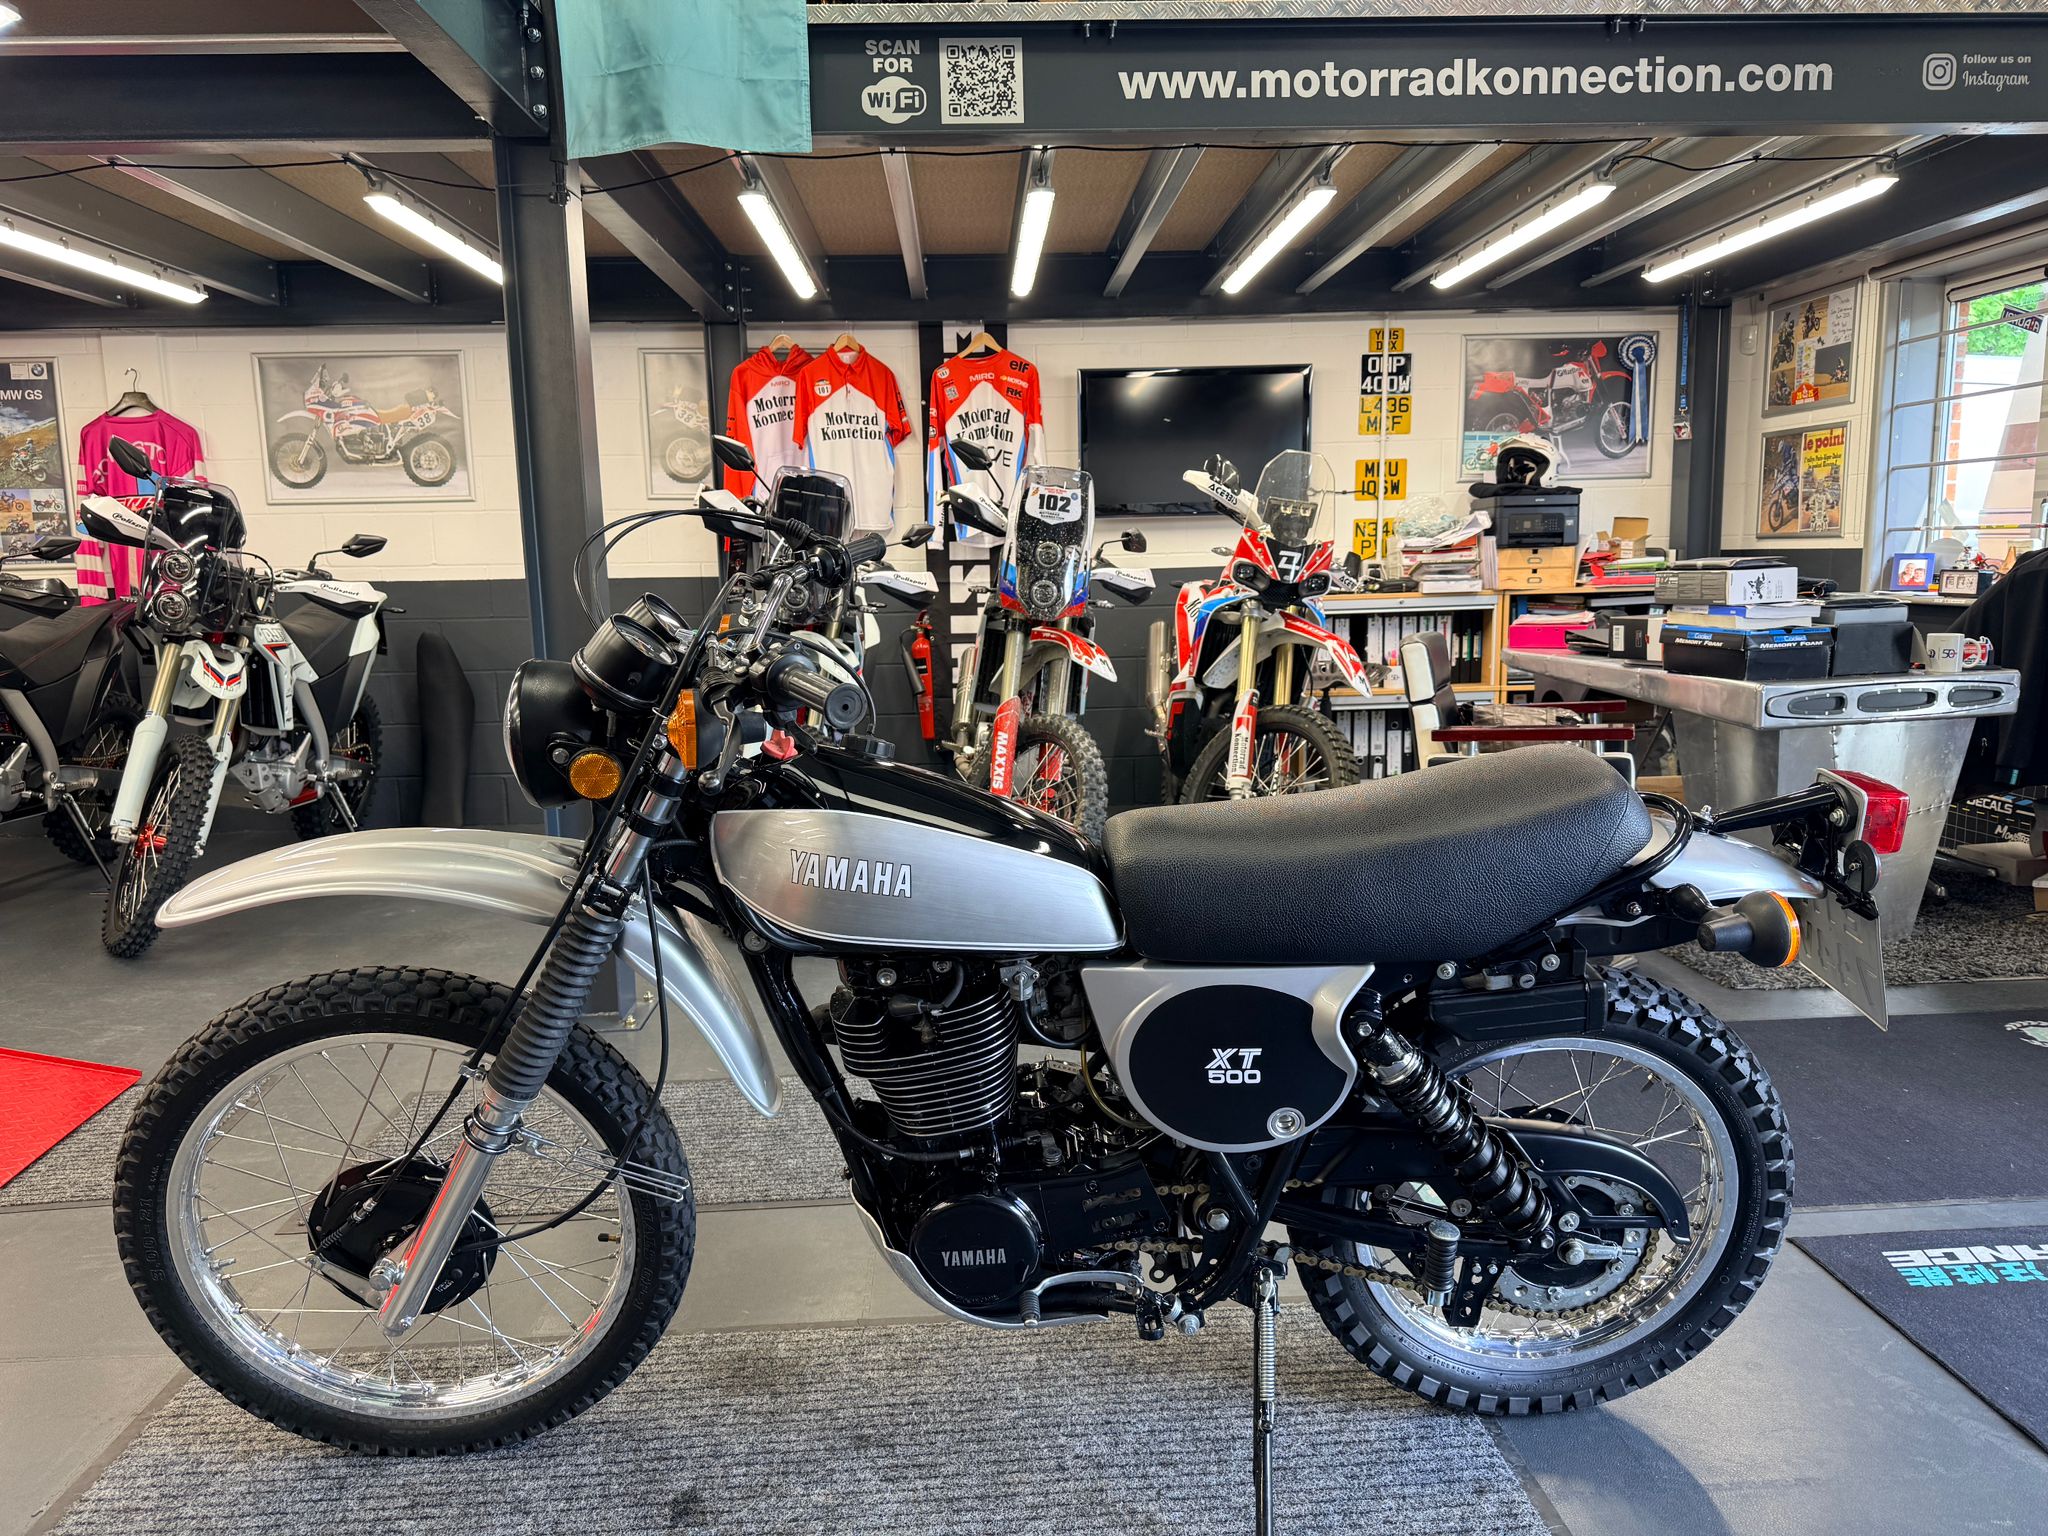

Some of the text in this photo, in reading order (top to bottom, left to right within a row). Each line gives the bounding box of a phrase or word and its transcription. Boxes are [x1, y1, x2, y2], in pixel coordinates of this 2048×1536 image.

[865, 39, 920, 55] SCAN
[872, 57, 913, 73] FOR
[1963, 54, 2031, 64] follow us on
[1118, 56, 1833, 100] www.motorradkonnection.com
[1962, 70, 2031, 92] Instagram
[1376, 341, 1398, 351] DX
[1009, 360, 1030, 373] elf
[0, 389, 43, 401] MW GS
[1006, 386, 1022, 398] RK
[754, 395, 796, 413] Motorr
[418, 412, 432, 428] 38
[677, 408, 694, 424] 38
[751, 410, 795, 429] Konnec
[1803, 433, 1814, 451] le
[1039, 493, 1071, 513] 102
[112, 512, 147, 531] Polispo
[1355, 522, 1395, 538] N34
[893, 573, 927, 587] Polisport
[320, 583, 360, 597] Polisport
[1674, 638, 1724, 648] MEMORY FOAM
[992, 731, 1009, 790] MAXXIS
[1239, 736, 1247, 771] Motorrad
[790, 849, 912, 898] YAMAHA
[1205, 1048, 1262, 1069] XT
[1208, 1069, 1262, 1084] 500
[941, 1248, 1007, 1267] YAMAHA
